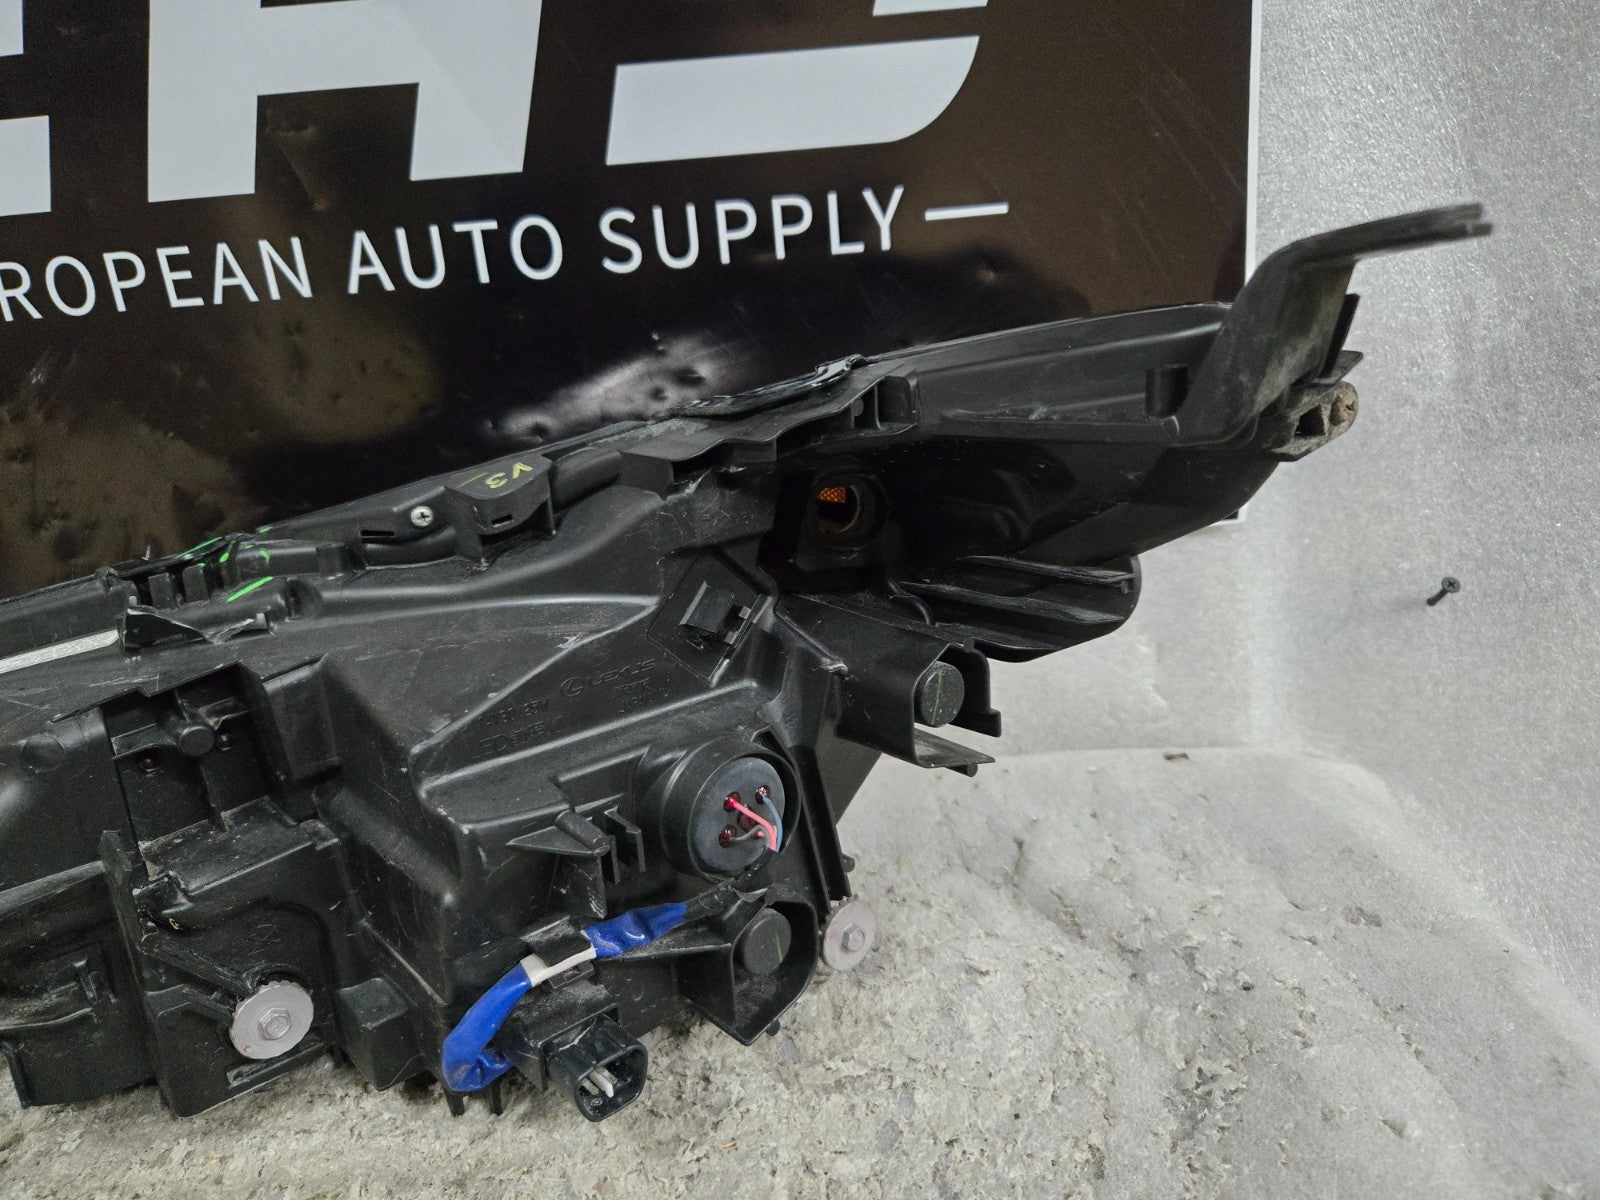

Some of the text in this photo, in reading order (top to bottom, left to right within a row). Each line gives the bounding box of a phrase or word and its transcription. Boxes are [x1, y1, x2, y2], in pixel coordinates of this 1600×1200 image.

[0, 185, 905, 322] ROPEAN AUTO SUPPLY
